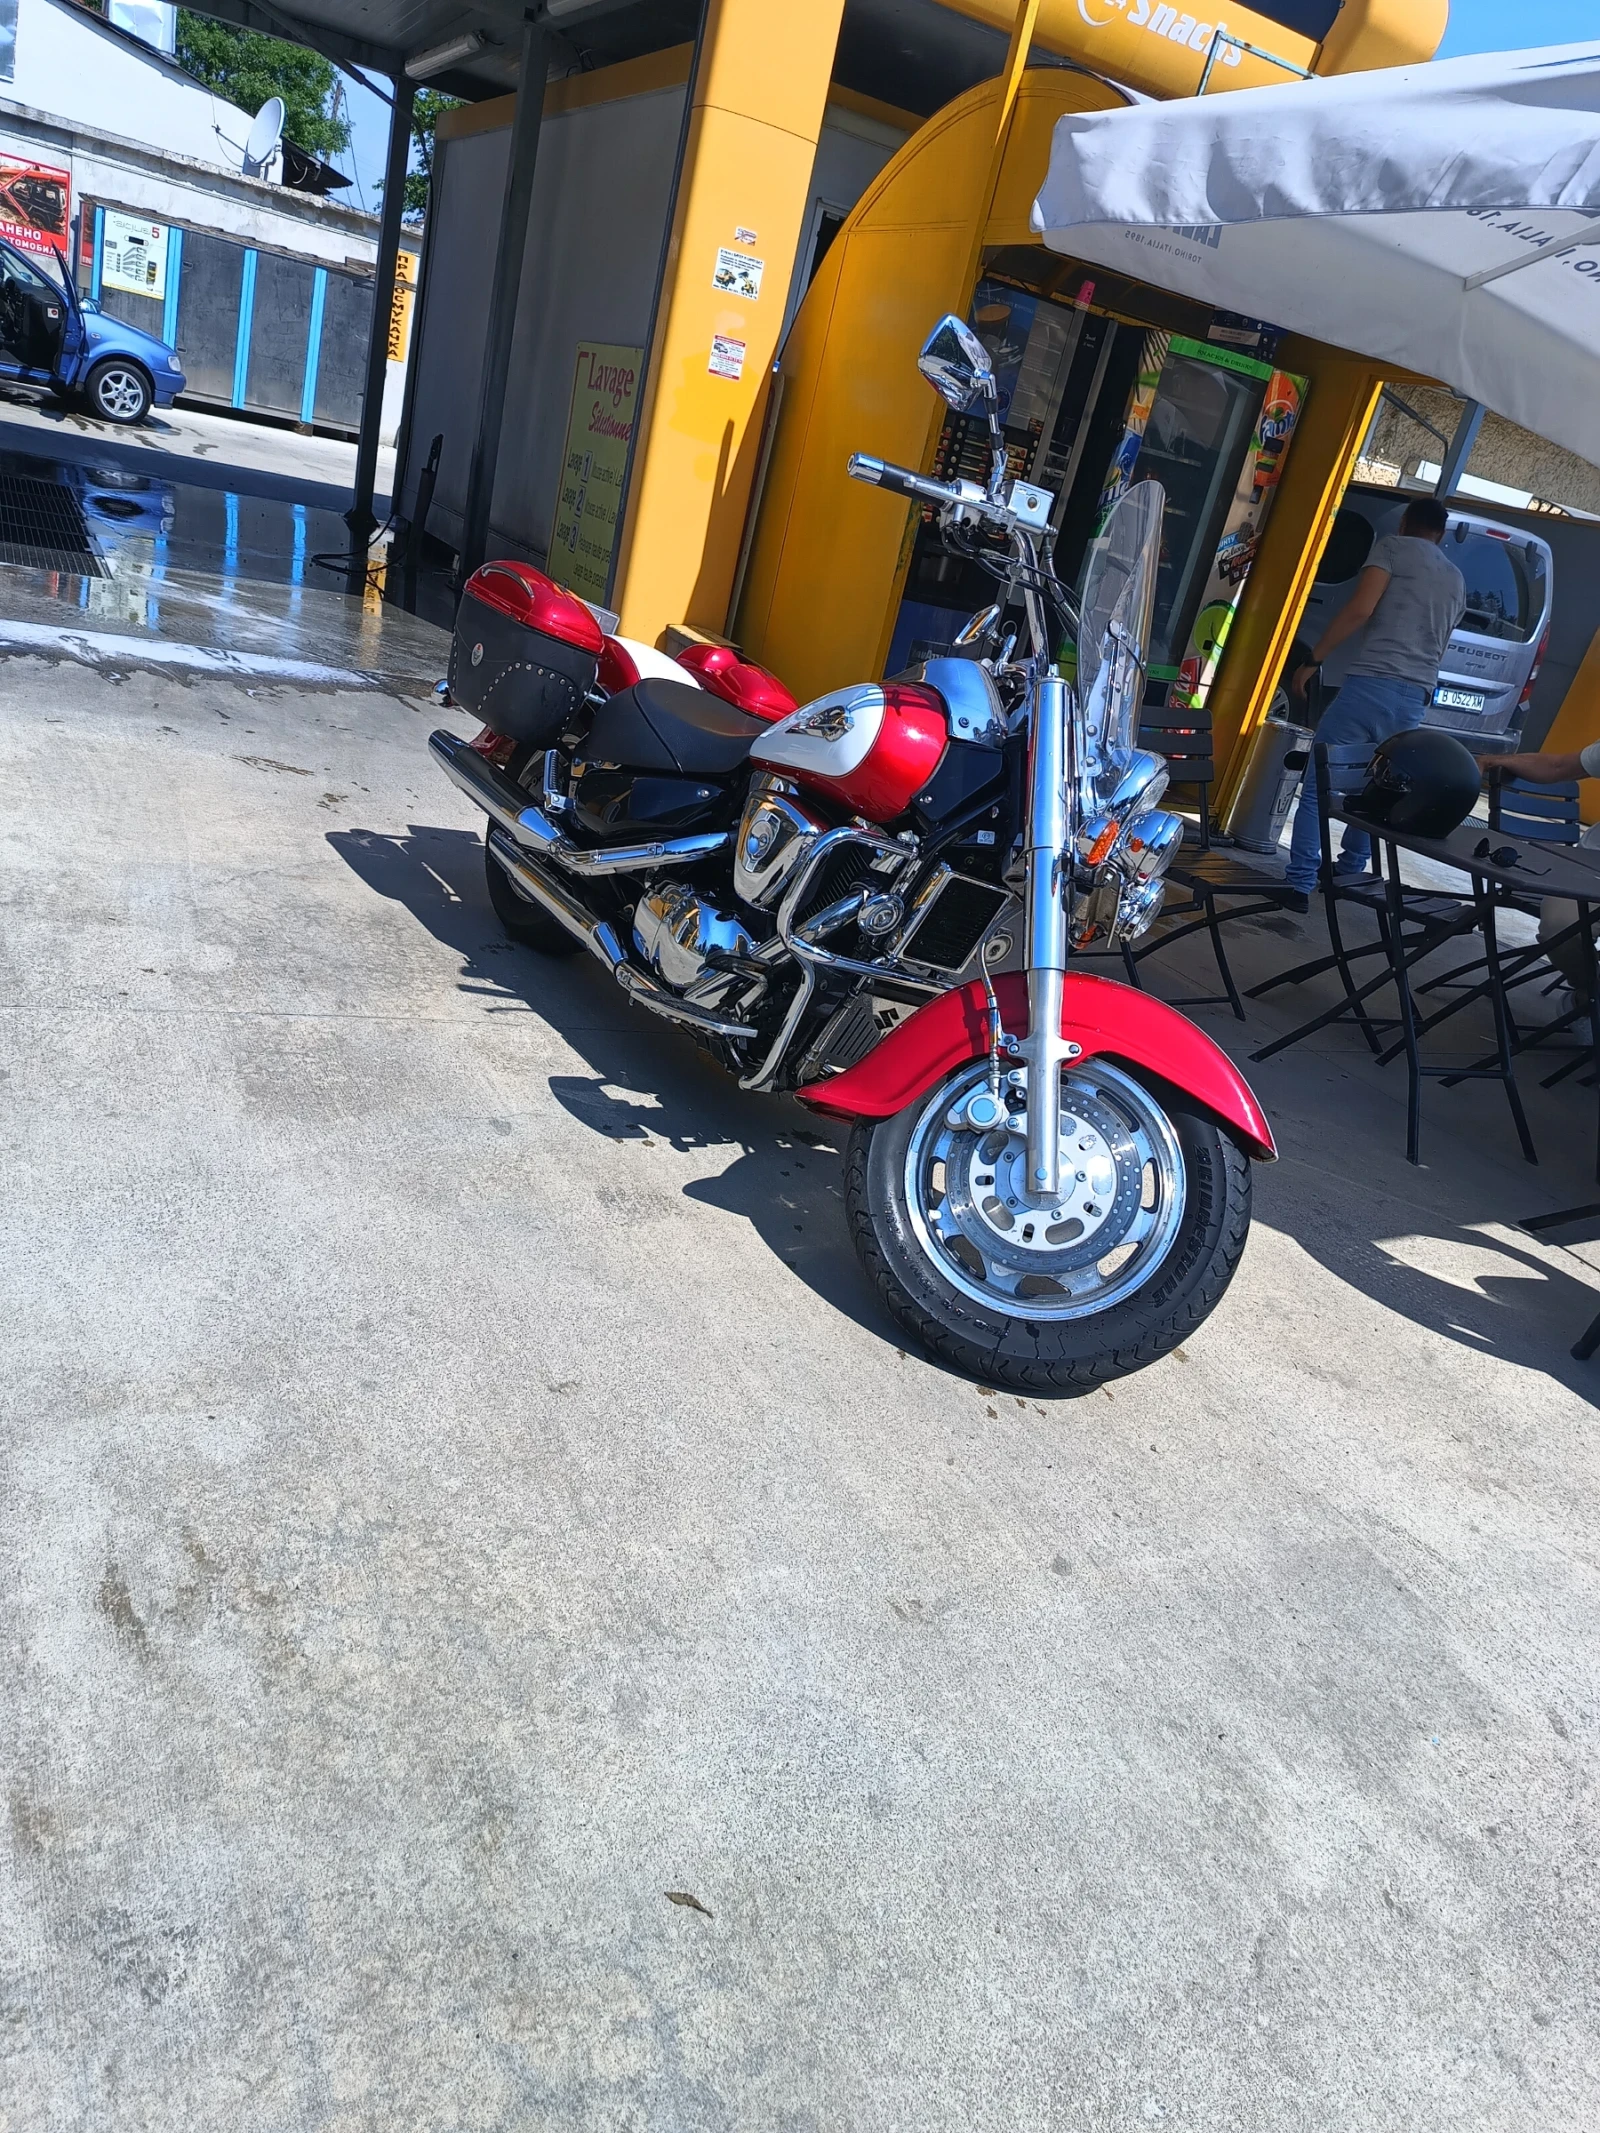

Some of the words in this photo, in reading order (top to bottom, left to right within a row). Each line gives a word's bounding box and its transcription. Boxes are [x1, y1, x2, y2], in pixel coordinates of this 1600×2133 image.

[1126, 0, 1242, 68] Snacks
[0, 221, 42, 240] АНЕНО
[387, 254, 409, 358] ПРАОСМУКАЧКА
[1197, 349, 1225, 363] SNACKS
[587, 353, 635, 408] Lavage
[576, 488, 584, 513] 2
[570, 525, 577, 551] 3
[1447, 643, 1508, 662] PEUGEOT
[1150, 1143, 1214, 1310] BRIDGESTONE
